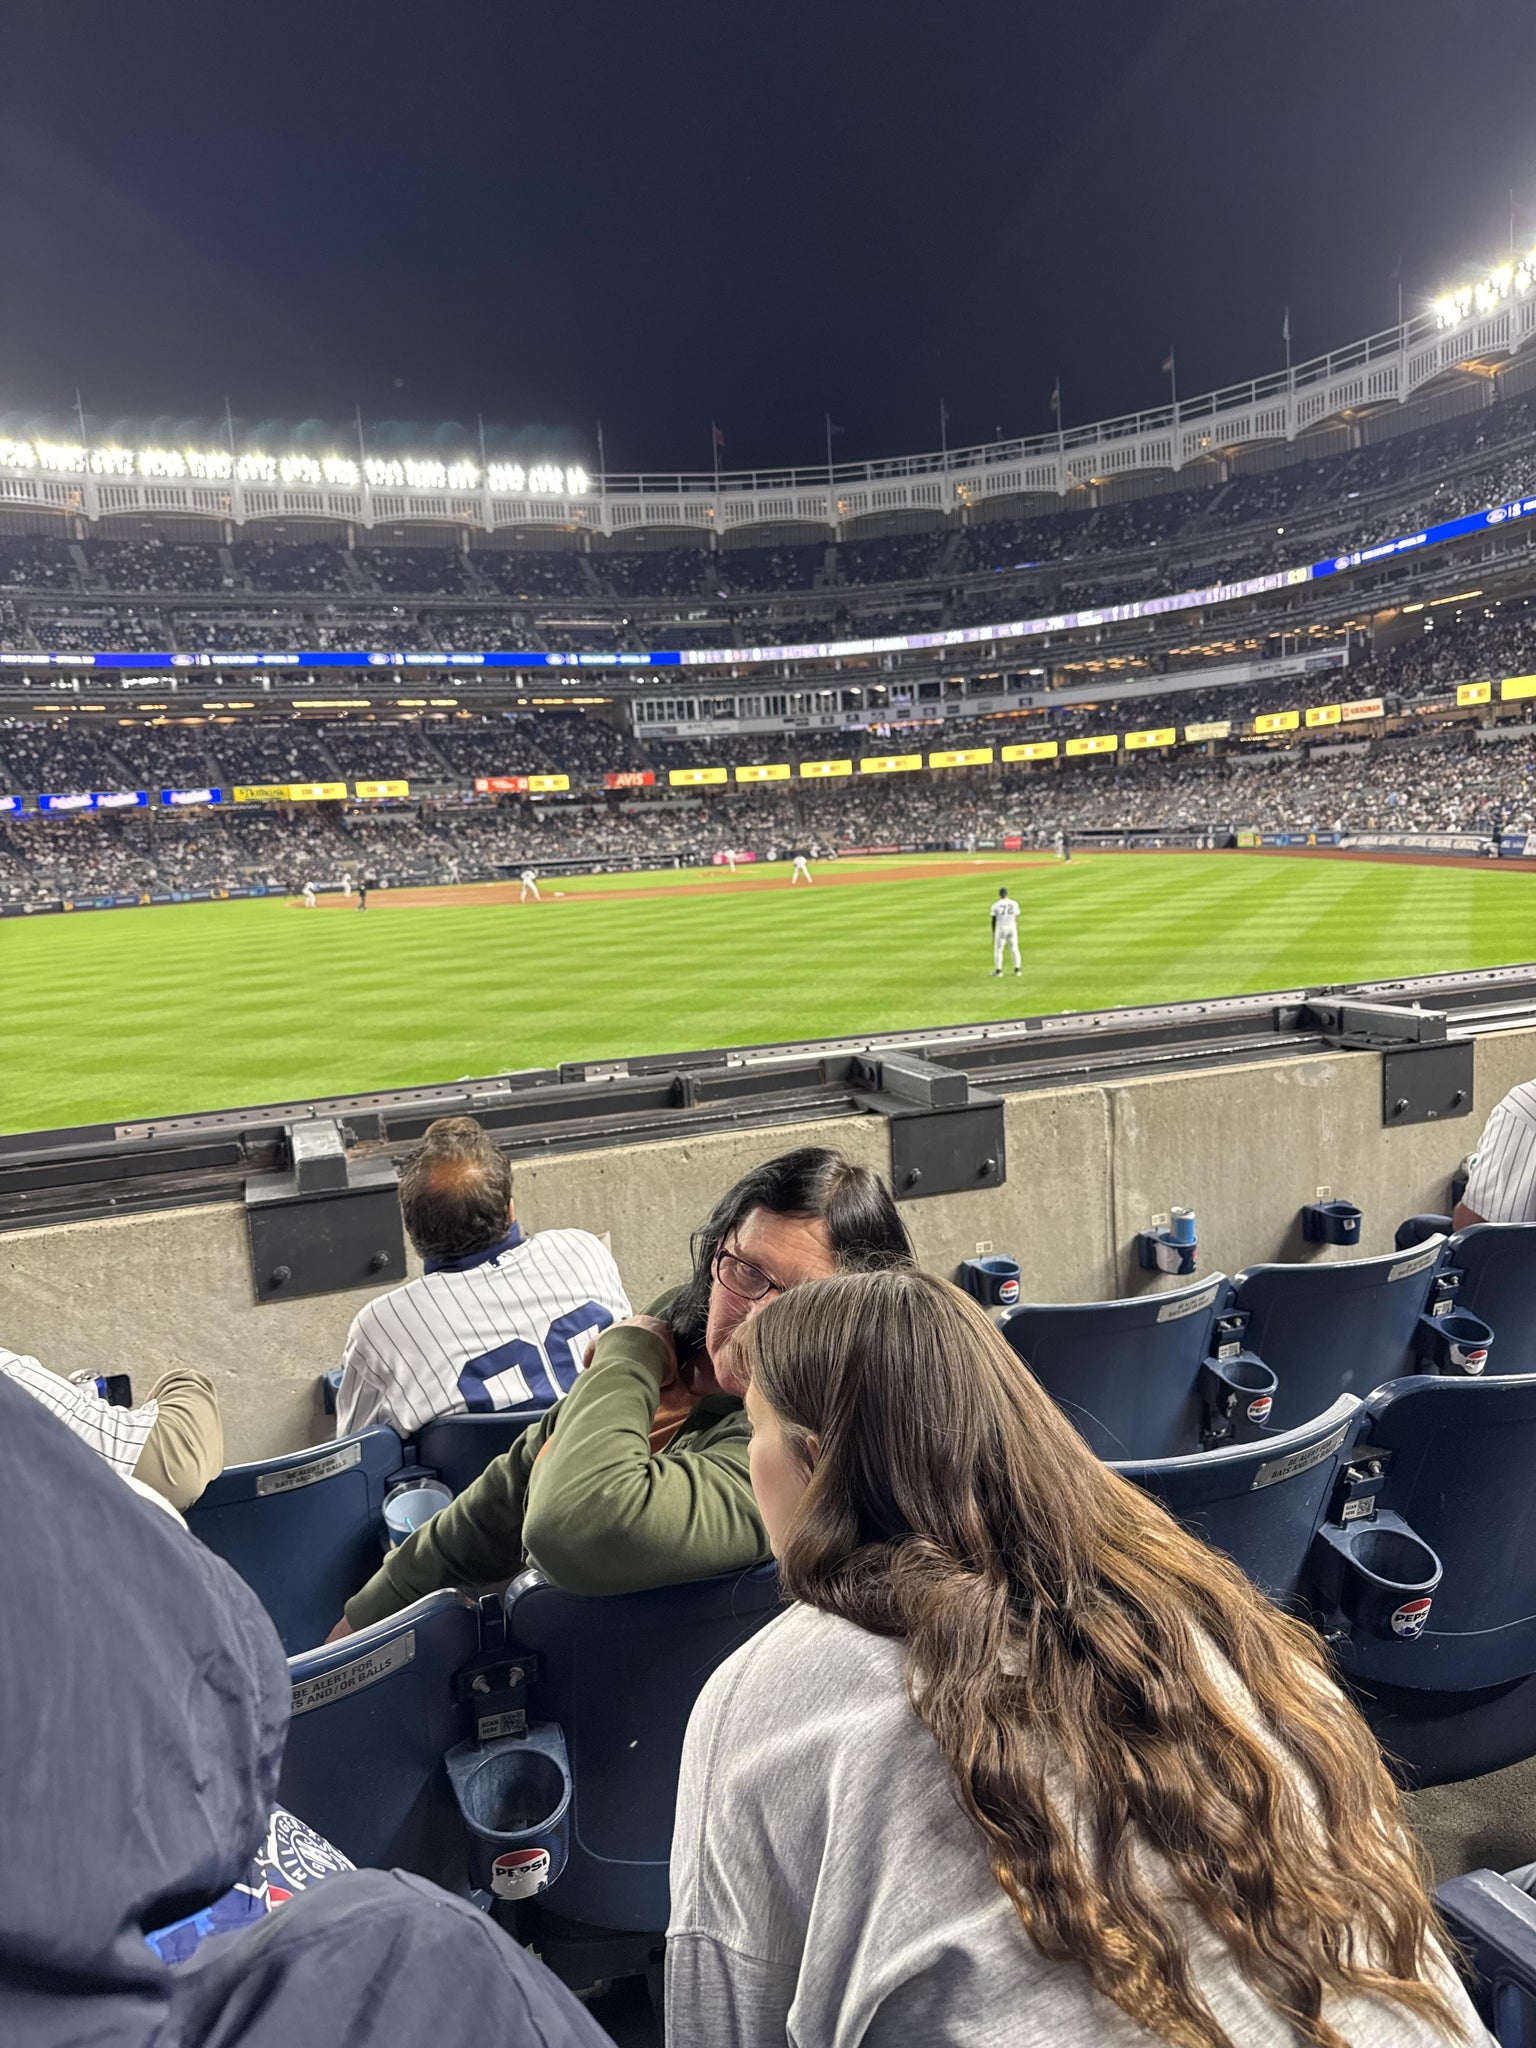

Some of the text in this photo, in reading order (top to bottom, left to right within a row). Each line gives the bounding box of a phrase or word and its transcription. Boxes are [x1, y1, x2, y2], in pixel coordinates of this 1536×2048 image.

[616, 773, 644, 786] AVIS
[1000, 904, 1014, 916] 72
[1271, 1466, 1290, 1479] BATS
[274, 1478, 294, 1489] BATS
[358, 1658, 392, 1681] BALLS
[293, 1659, 374, 1700] BE ALERT FOR
[482, 1720, 499, 1728] SCAN
